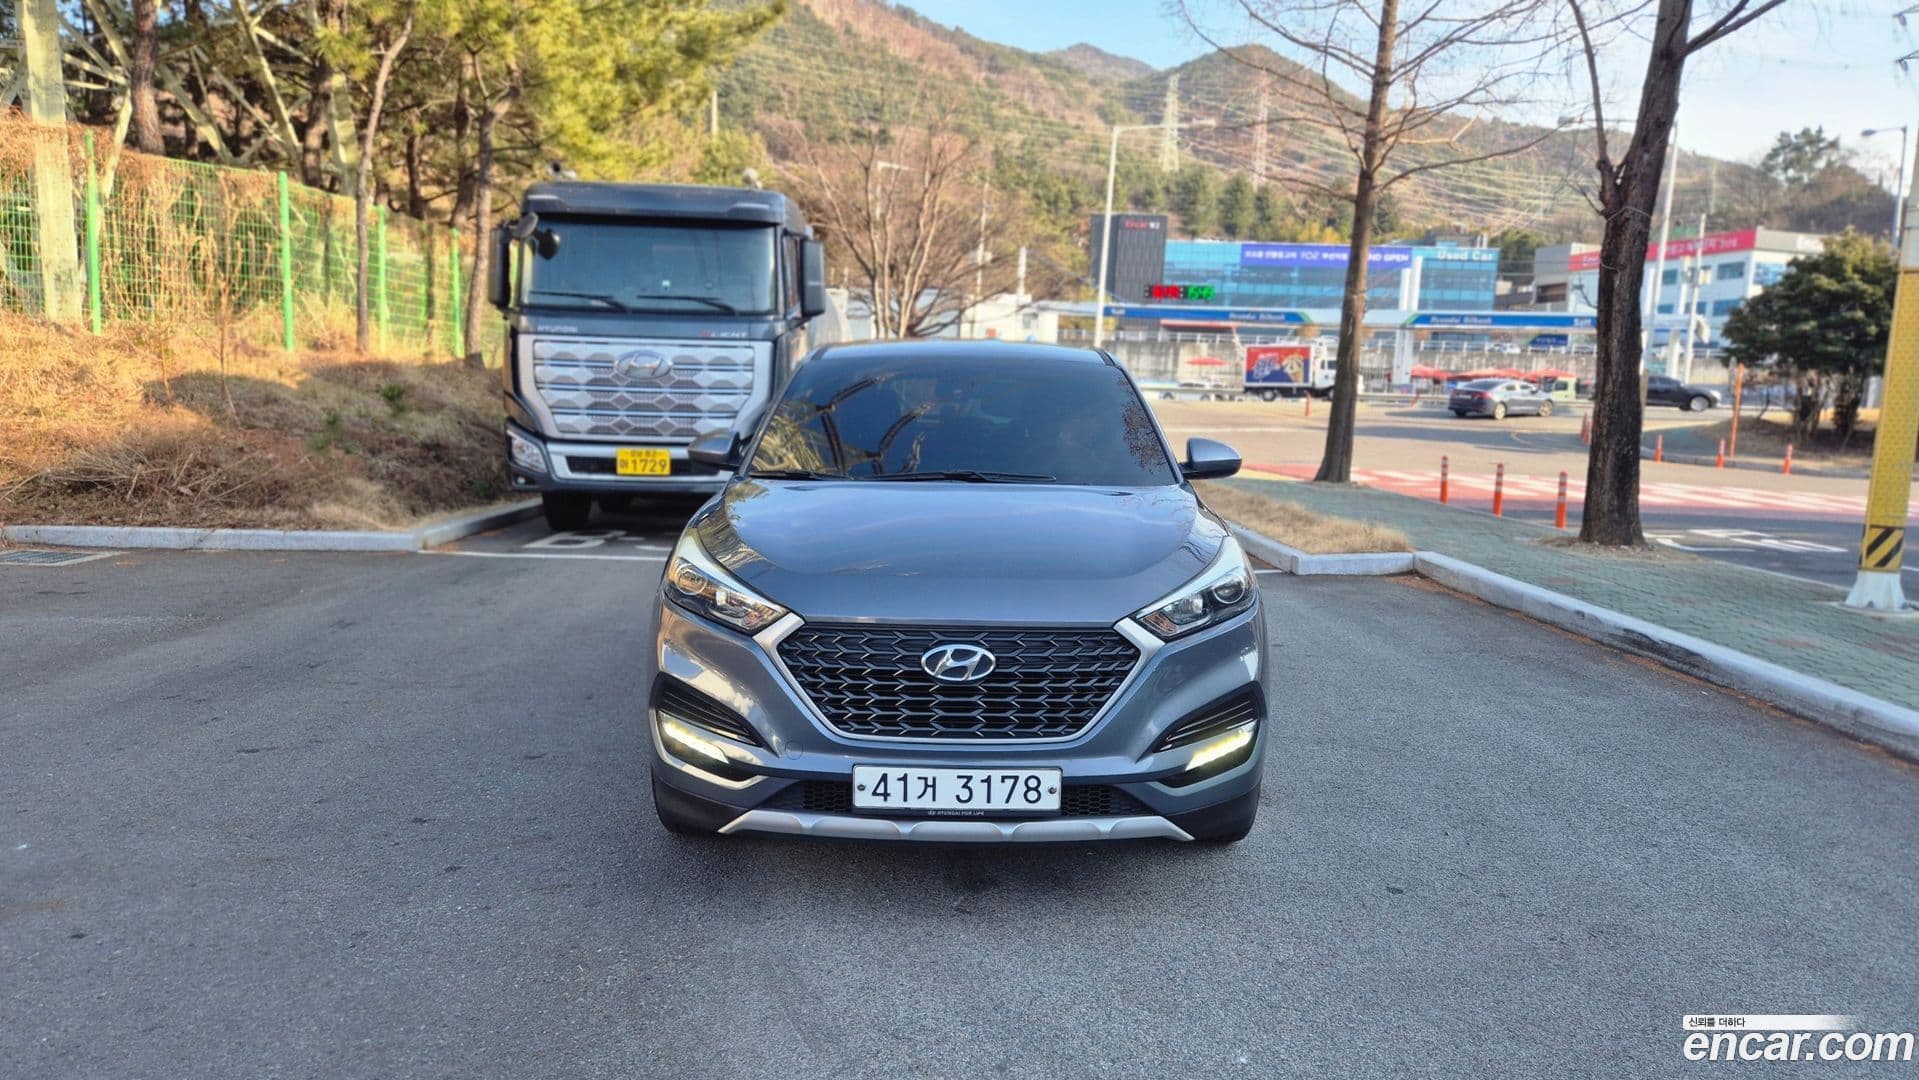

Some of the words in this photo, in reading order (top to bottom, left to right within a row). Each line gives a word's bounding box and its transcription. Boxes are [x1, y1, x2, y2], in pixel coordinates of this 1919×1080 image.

[1384, 254, 1408, 262] OPEN
[1437, 250, 1467, 260] Used
[1472, 250, 1493, 260] Car
[537, 325, 578, 333] HYUNDAI
[631, 459, 667, 472] 1729
[871, 773, 937, 803] 41거
[955, 775, 1042, 804] 3178
